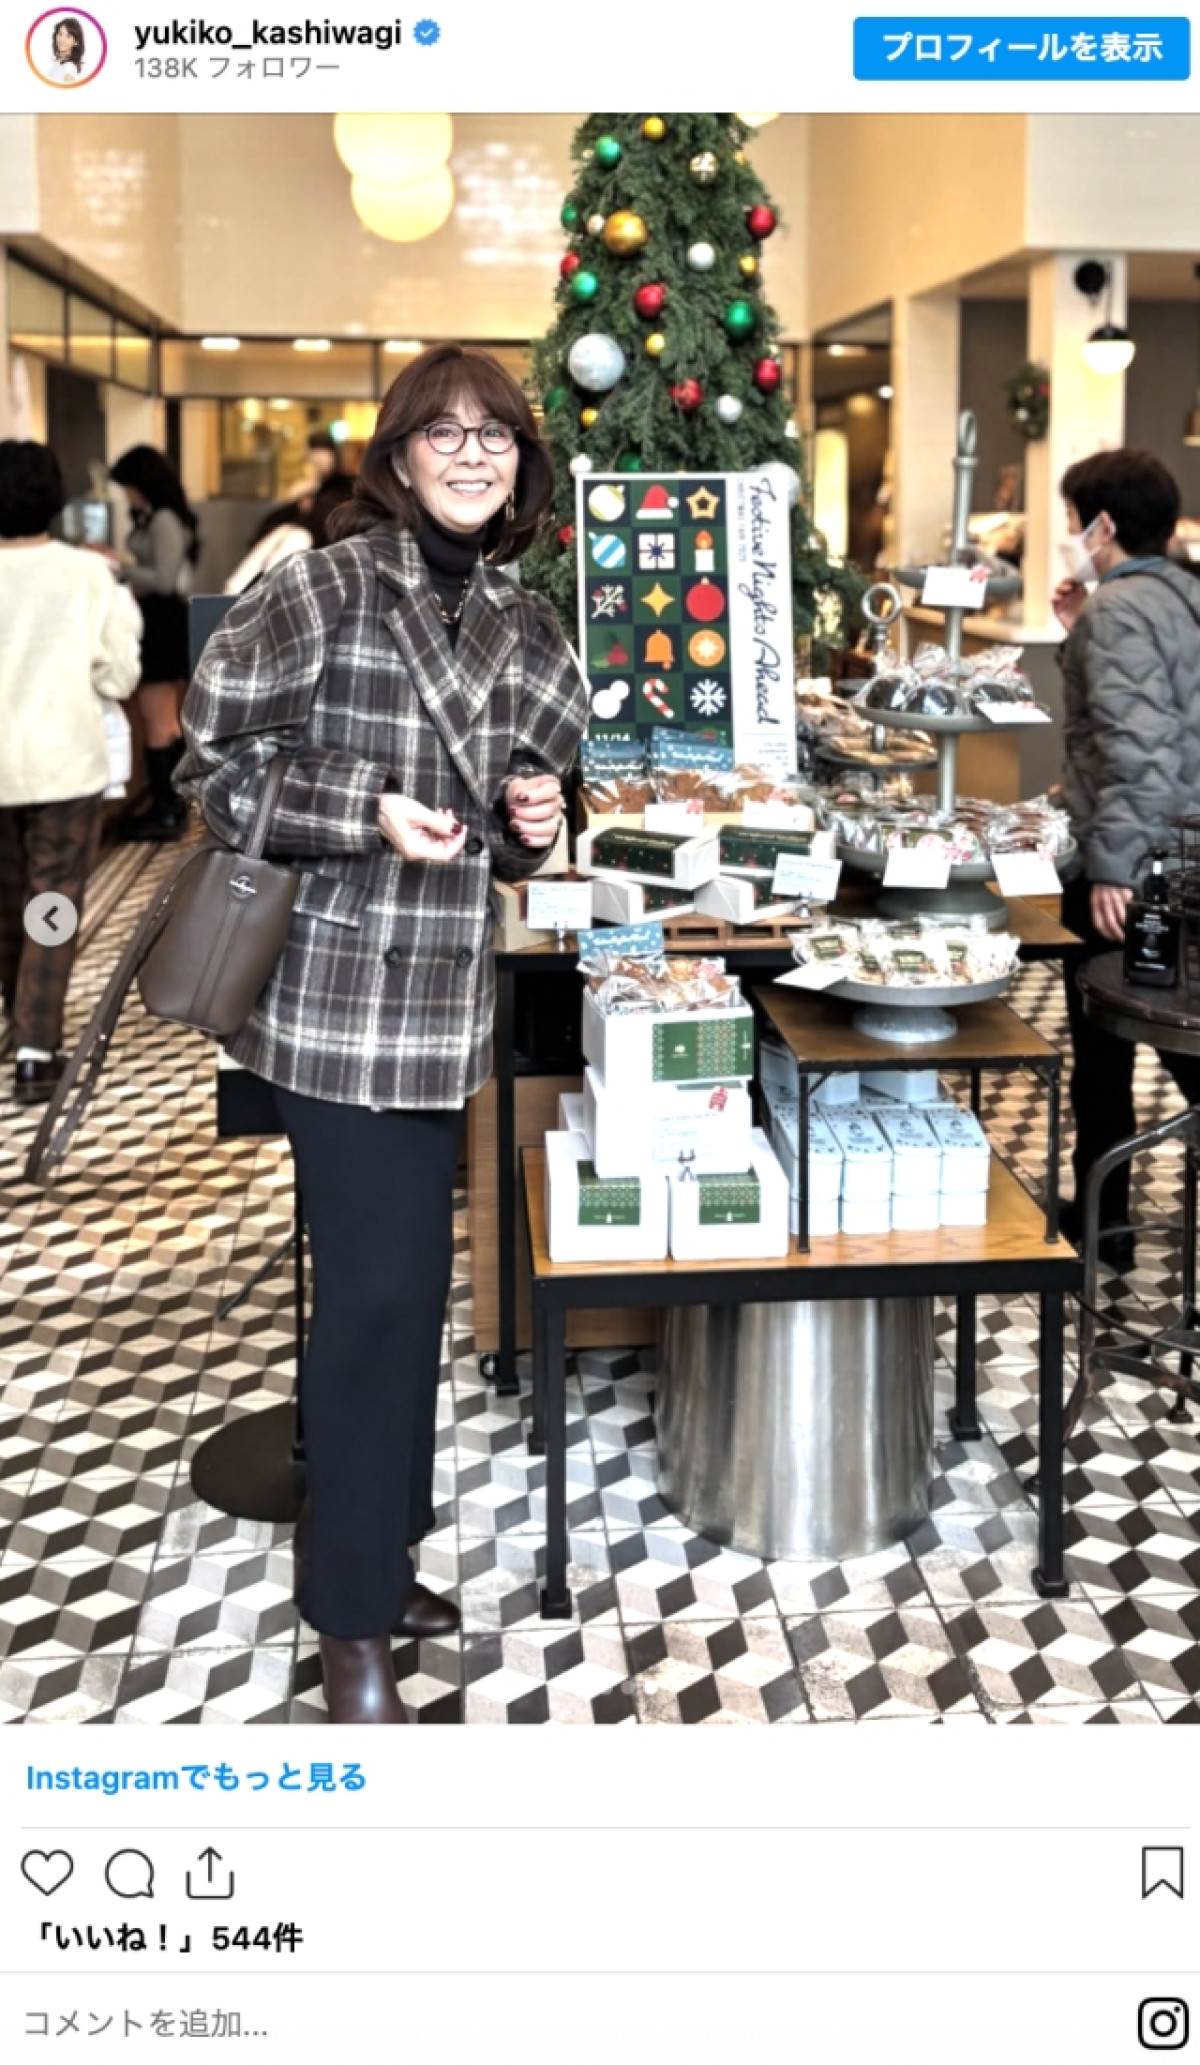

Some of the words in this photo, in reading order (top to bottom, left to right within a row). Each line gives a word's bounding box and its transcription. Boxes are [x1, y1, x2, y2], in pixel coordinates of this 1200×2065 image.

[750, 477, 777, 556] Festive
[738, 560, 778, 634] Nights
[752, 637, 781, 725] Ahead
